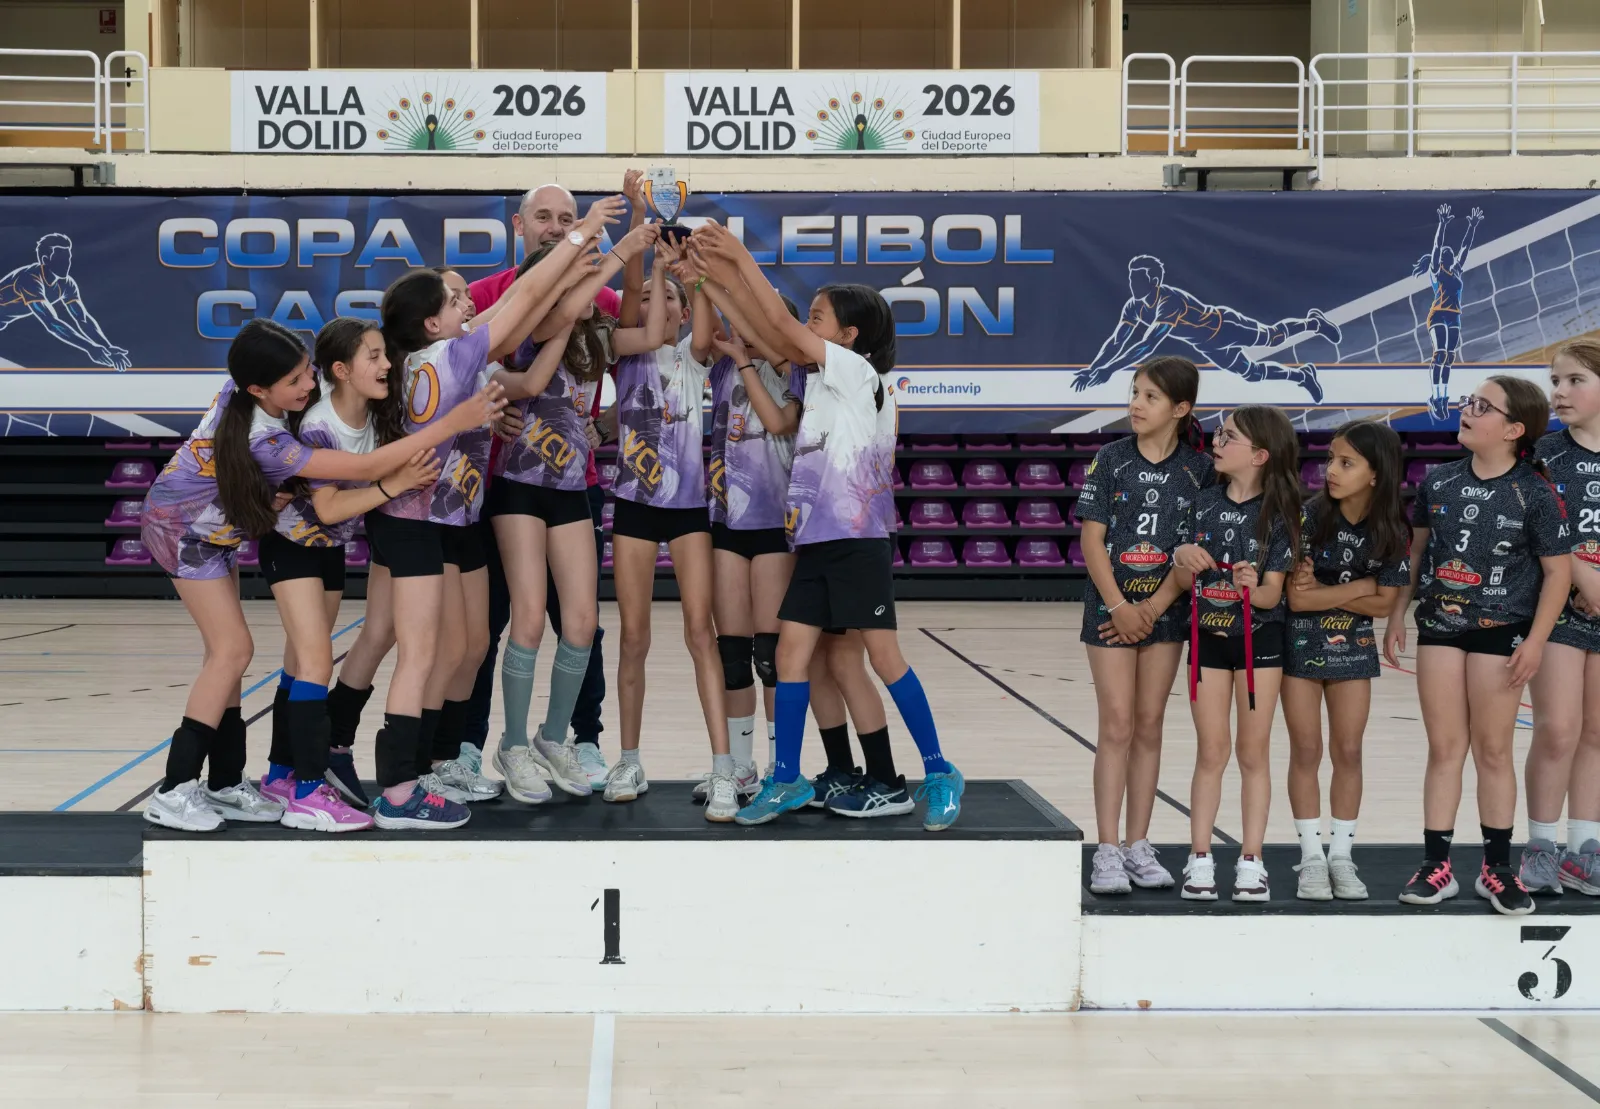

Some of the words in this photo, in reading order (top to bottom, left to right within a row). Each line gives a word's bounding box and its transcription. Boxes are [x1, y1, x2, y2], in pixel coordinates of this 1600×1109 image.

[255, 85, 366, 116] VALLA
[492, 84, 586, 117] 2026
[684, 86, 795, 116] VALLA
[922, 84, 1015, 117] 2026
[257, 120, 367, 151] DOLID
[492, 130, 533, 141] Ciudad
[535, 130, 582, 144] Europea
[687, 121, 796, 151] DOLID
[921, 130, 963, 141] Ciudad
[964, 130, 1011, 144] Europea
[492, 140, 511, 150] del
[513, 141, 559, 151] Deporte
[921, 140, 939, 150] del
[941, 141, 988, 151] Deporte
[158, 217, 425, 268] COPA
[444, 218, 524, 267] D
[881, 267, 1015, 337] ÓN
[907, 382, 982, 396] merchanvip
[1576, 462, 1600, 473] air
[1136, 513, 1159, 535] 21
[1455, 529, 1471, 552] 3
[1125, 554, 1149, 562] MORENO
[1438, 569, 1460, 581] MORENO
[1123, 578, 1161, 592] Real
[1482, 587, 1507, 596] Soria
[1200, 612, 1236, 628] Real
[1320, 616, 1353, 630] Real
[591, 888, 626, 965] 1
[1518, 926, 1573, 1002] 3
